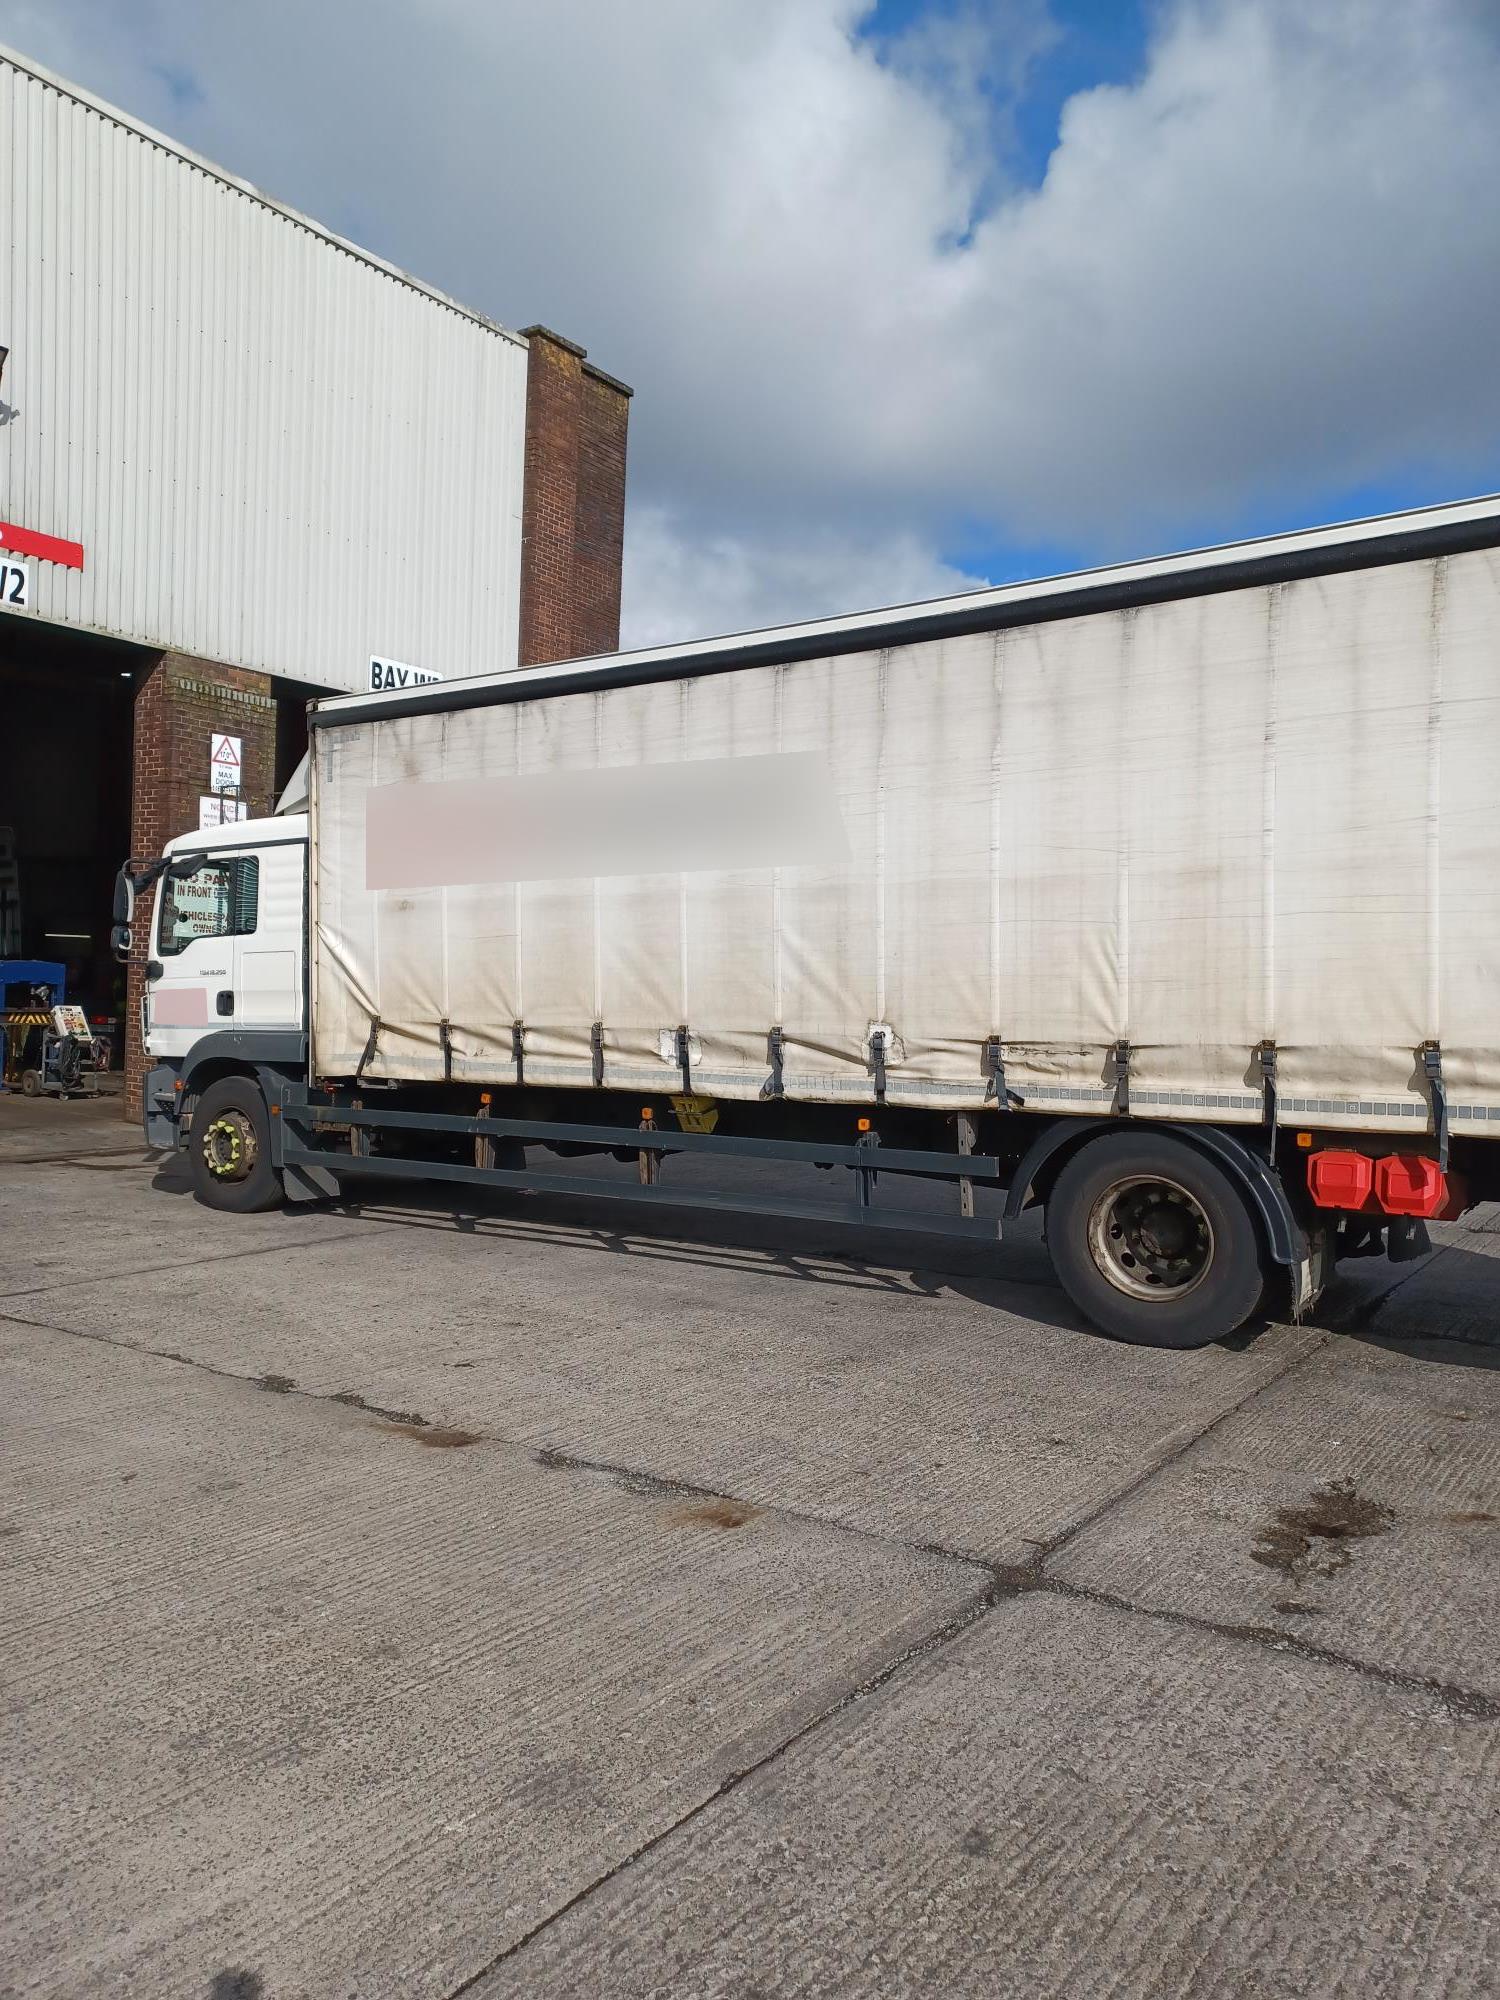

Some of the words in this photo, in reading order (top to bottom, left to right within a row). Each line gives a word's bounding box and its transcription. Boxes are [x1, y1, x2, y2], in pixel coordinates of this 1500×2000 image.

[0, 565, 25, 605] 2
[372, 661, 409, 689] BAY
[218, 771, 233, 779] MAX
[210, 803, 238, 813] NOTIC
[177, 885, 185, 897] IN
[187, 886, 212, 898] FRONT
[180, 910, 219, 922] EHICLES
